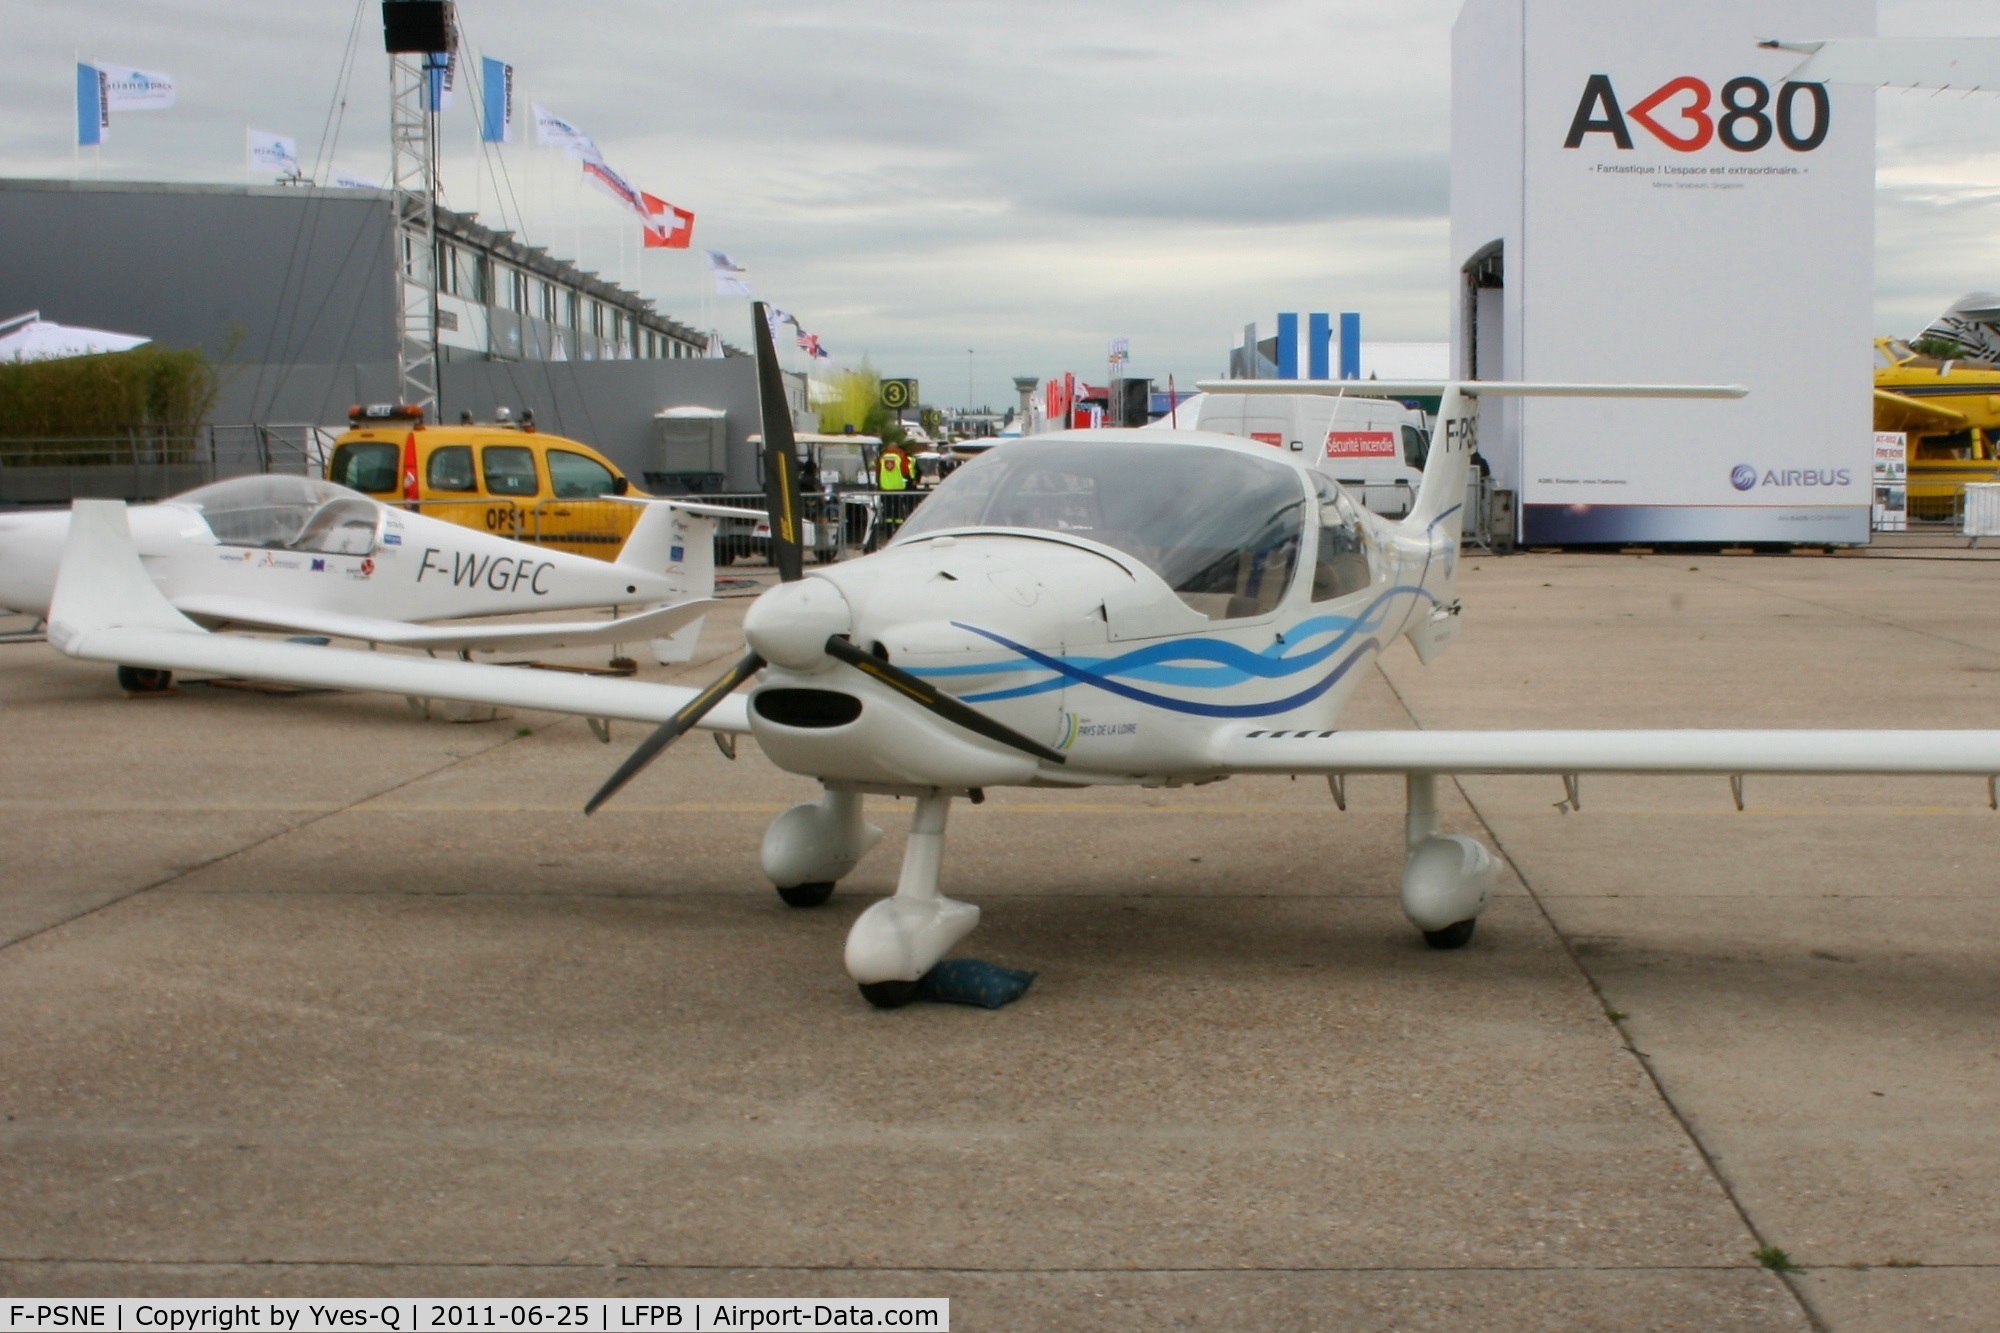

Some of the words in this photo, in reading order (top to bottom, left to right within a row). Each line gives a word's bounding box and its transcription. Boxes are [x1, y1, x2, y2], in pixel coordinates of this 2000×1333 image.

[1597, 164, 1655, 175] Fantastique
[1709, 166, 1725, 175] est
[889, 385, 900, 401] 3
[1326, 437, 1359, 453] Sécurité
[1359, 437, 1393, 453] incendie
[1761, 469, 1850, 486] AIRBUS
[486, 508, 525, 531] OPS1
[417, 548, 556, 596] F-WGFC
